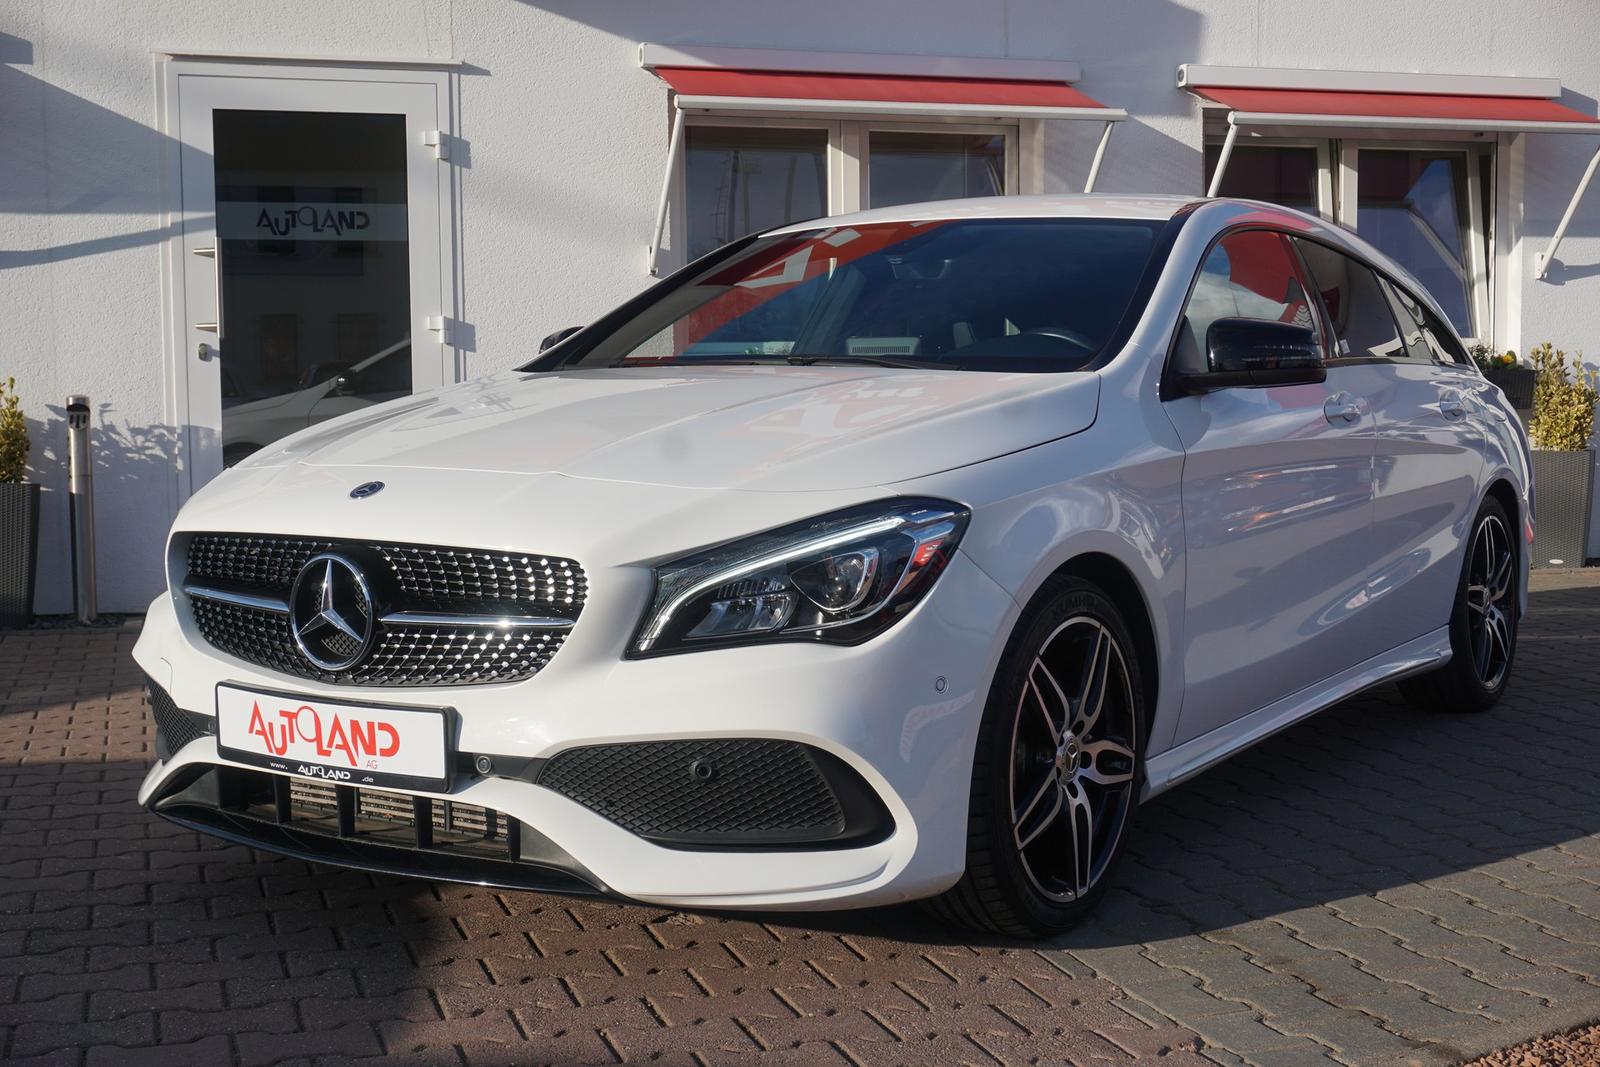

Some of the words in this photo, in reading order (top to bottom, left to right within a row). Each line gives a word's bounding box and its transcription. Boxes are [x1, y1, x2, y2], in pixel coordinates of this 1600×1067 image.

[256, 206, 370, 236] AUTOLAND
[248, 699, 400, 767] AUTOLAND
[366, 760, 378, 769] AG
